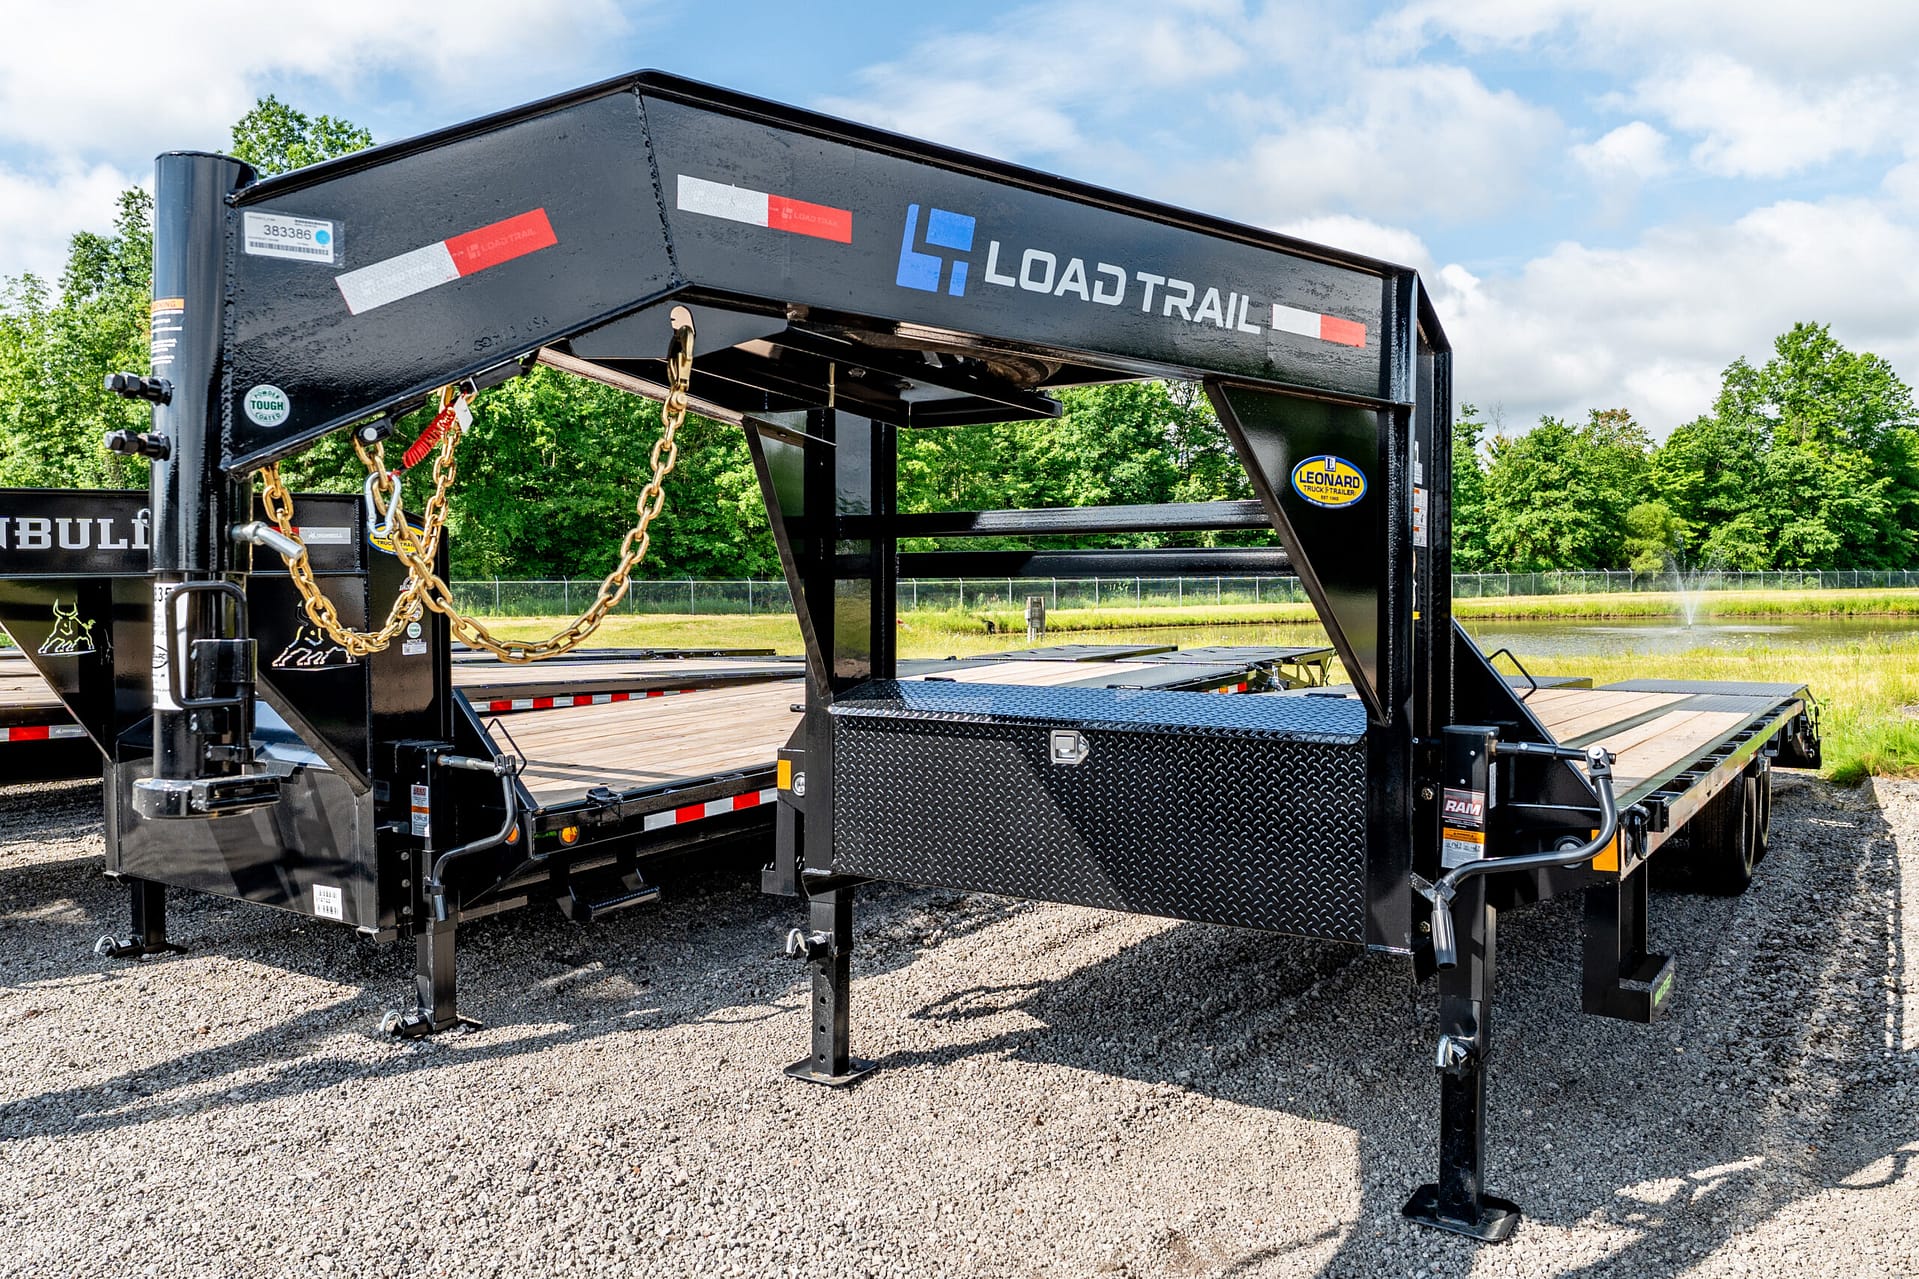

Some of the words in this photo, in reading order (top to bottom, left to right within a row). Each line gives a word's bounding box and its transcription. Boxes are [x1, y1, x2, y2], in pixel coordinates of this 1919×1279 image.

[263, 224, 312, 241] 383386
[984, 240, 1127, 306] LOAD
[1136, 271, 1261, 335] TRAIL
[250, 400, 284, 410] TOUGH
[1299, 470, 1360, 488] LEONARD
[1303, 485, 1324, 493] TRUCK
[1329, 487, 1355, 496] TRAILER
[1445, 799, 1482, 816] RAM
